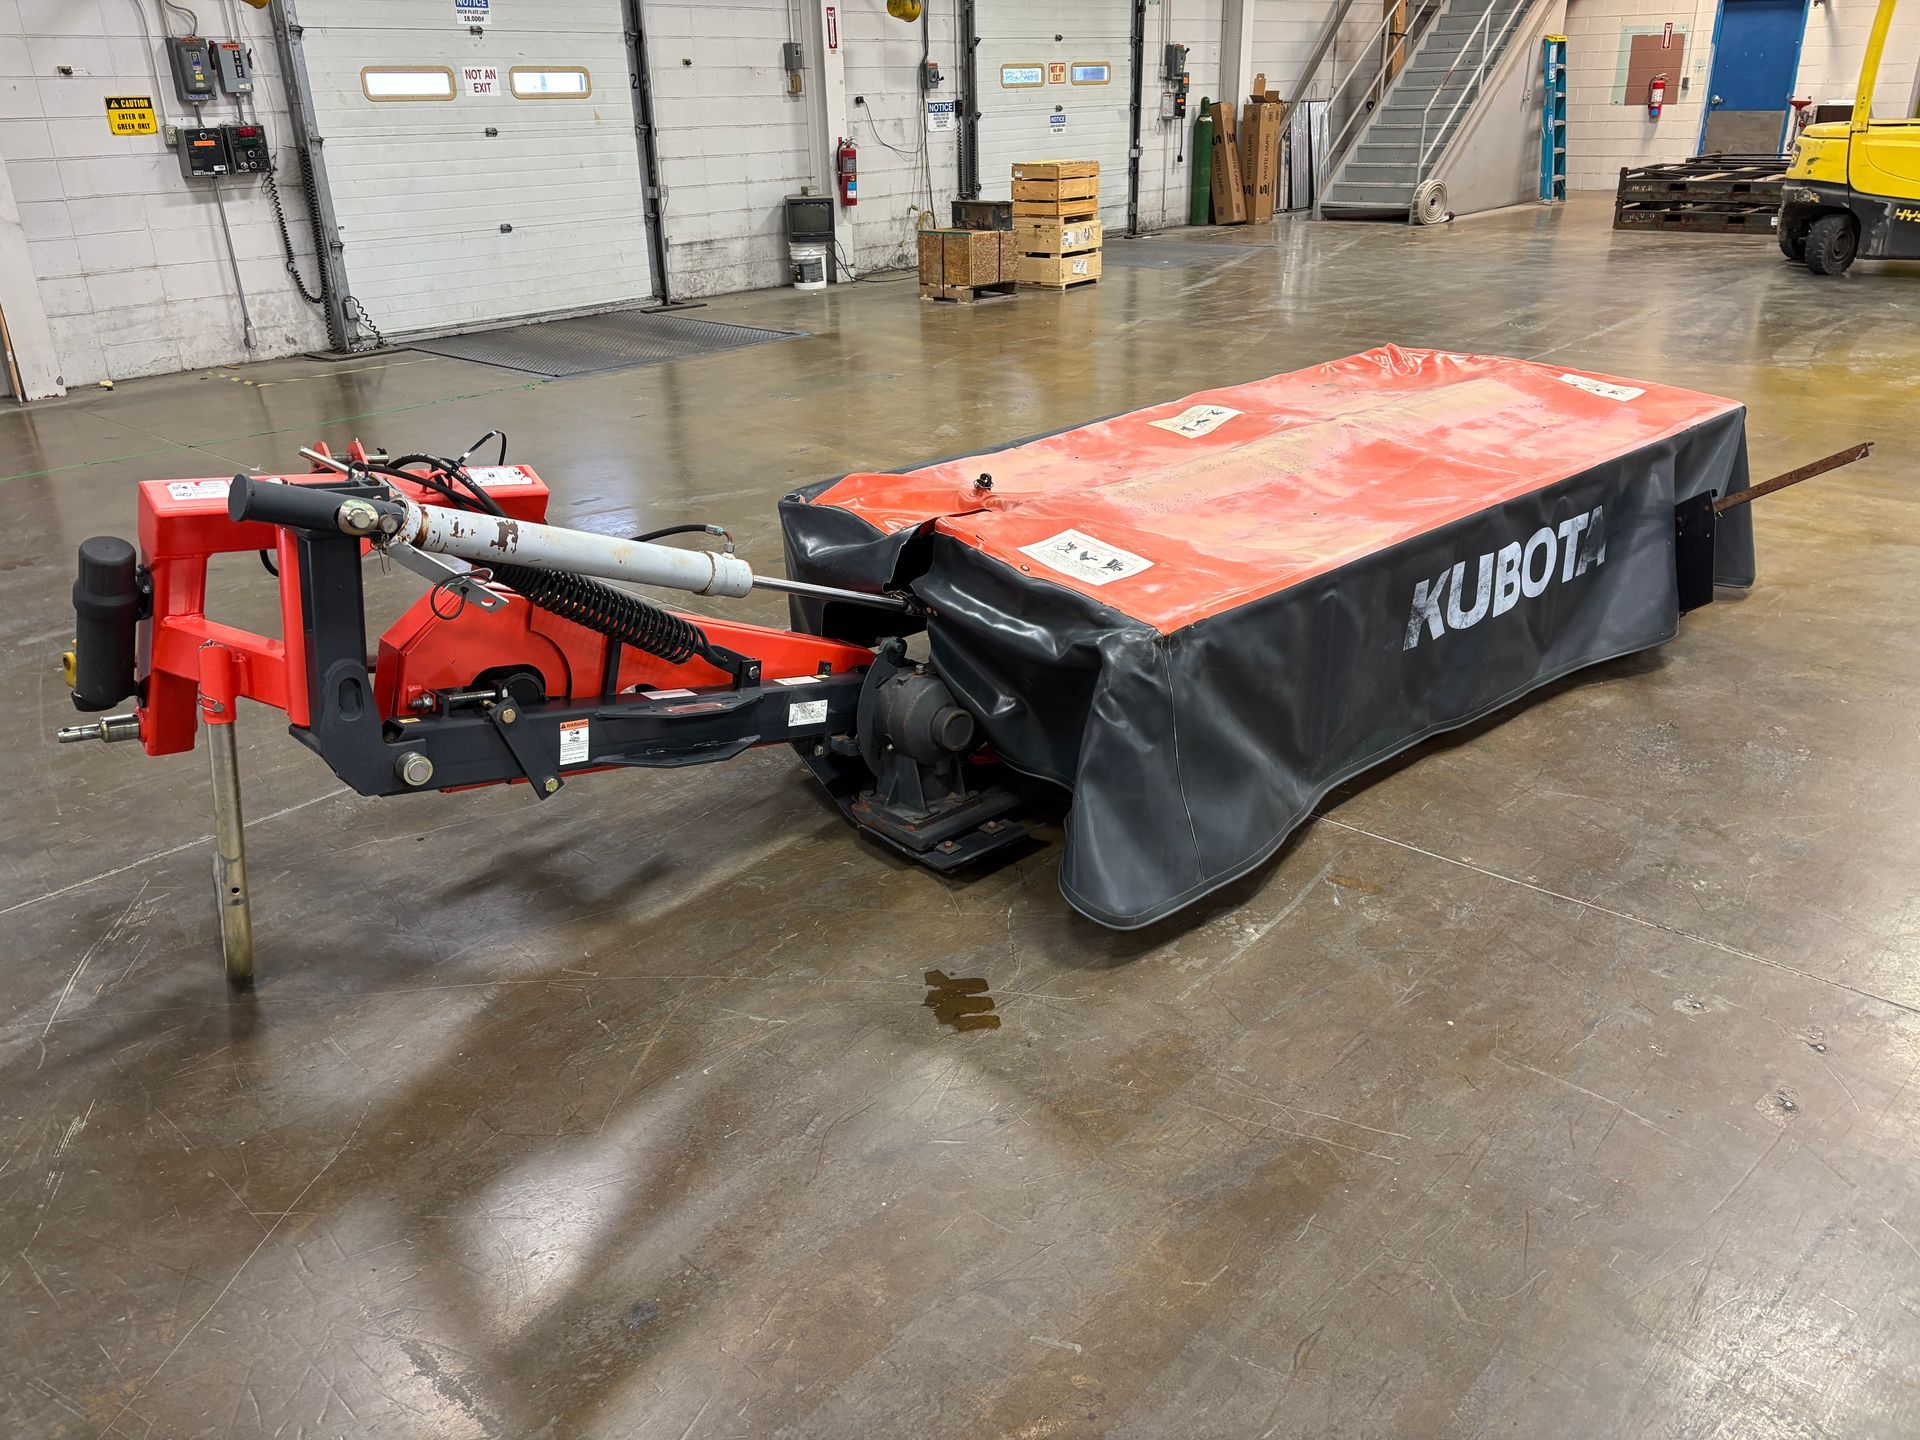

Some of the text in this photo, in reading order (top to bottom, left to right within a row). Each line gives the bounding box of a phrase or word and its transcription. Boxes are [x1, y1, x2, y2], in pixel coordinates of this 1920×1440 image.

[465, 69, 497, 80] NOT AN
[631, 73, 638, 89] 2
[473, 82, 492, 93] EXIT
[120, 99, 149, 108] CAUTION
[929, 103, 953, 112] NOTICE
[1217, 172, 1225, 195] LAMPS
[1403, 505, 1606, 651] KUBOTA
[566, 720, 588, 728] WARNING
